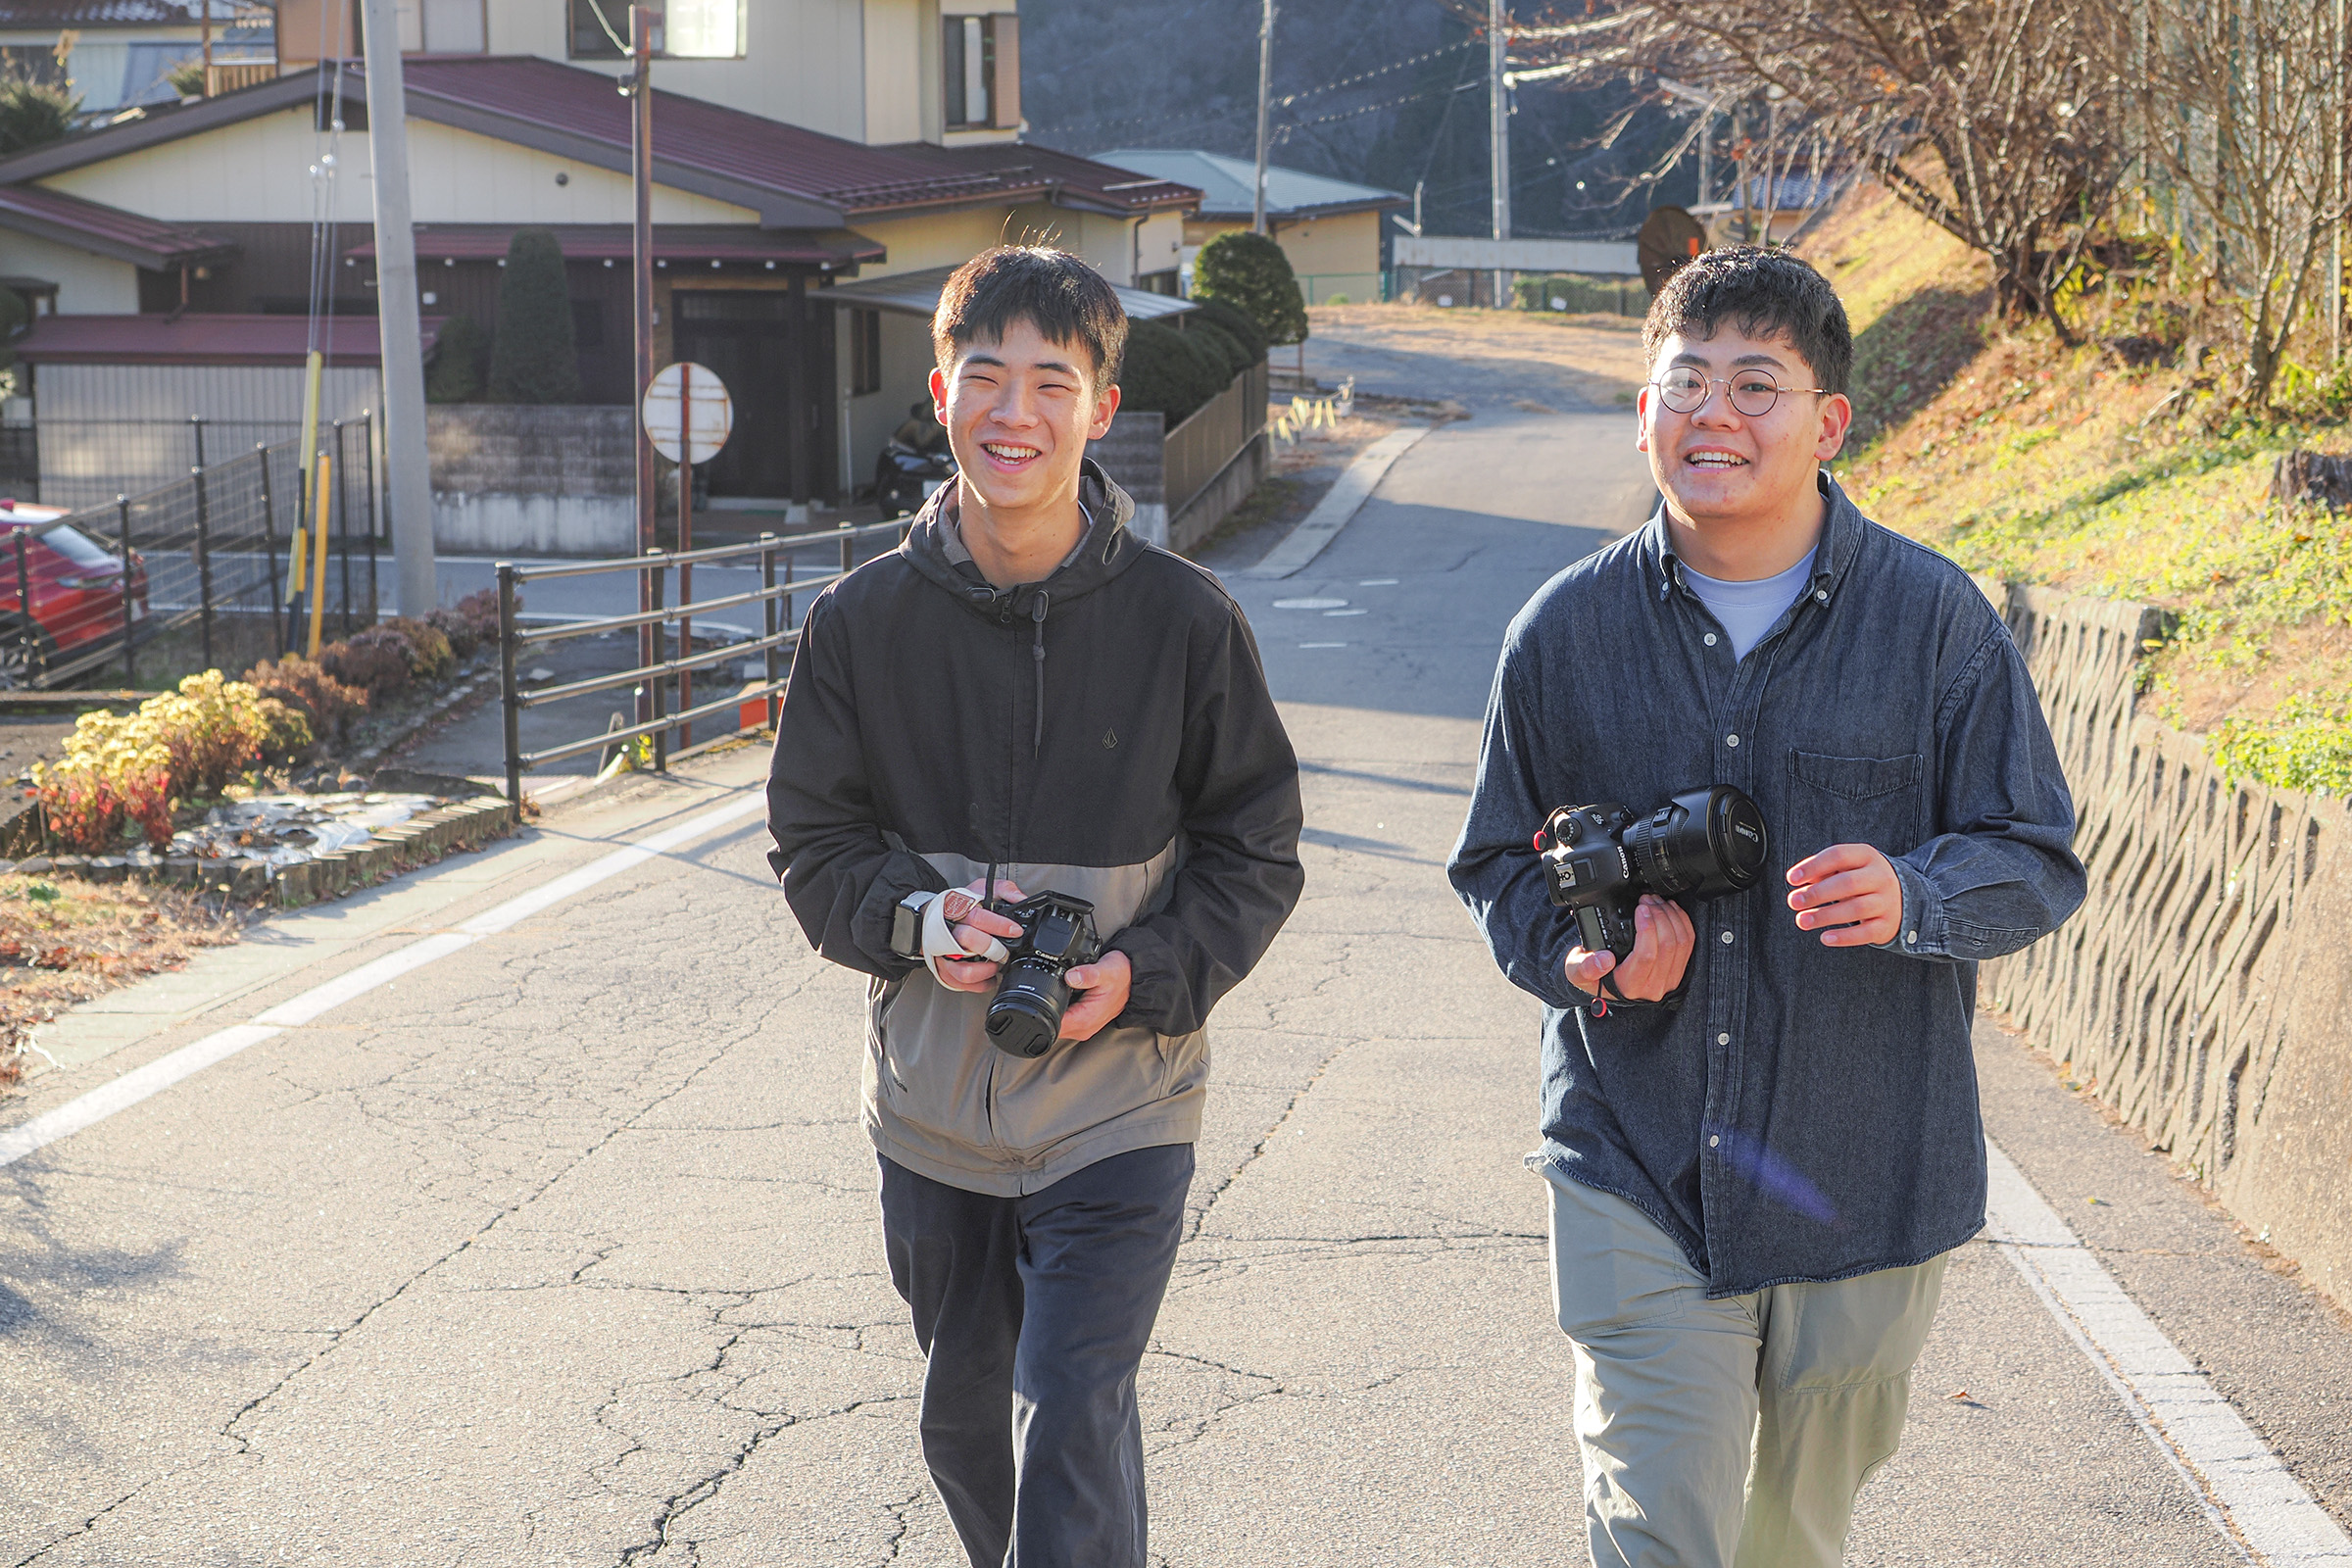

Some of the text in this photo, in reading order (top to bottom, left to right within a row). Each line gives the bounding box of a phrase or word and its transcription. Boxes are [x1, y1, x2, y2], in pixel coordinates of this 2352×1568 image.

[1735, 824, 1759, 843] Canon
[1617, 846, 1630, 879] Canon
[1035, 950, 1059, 961] Canon
